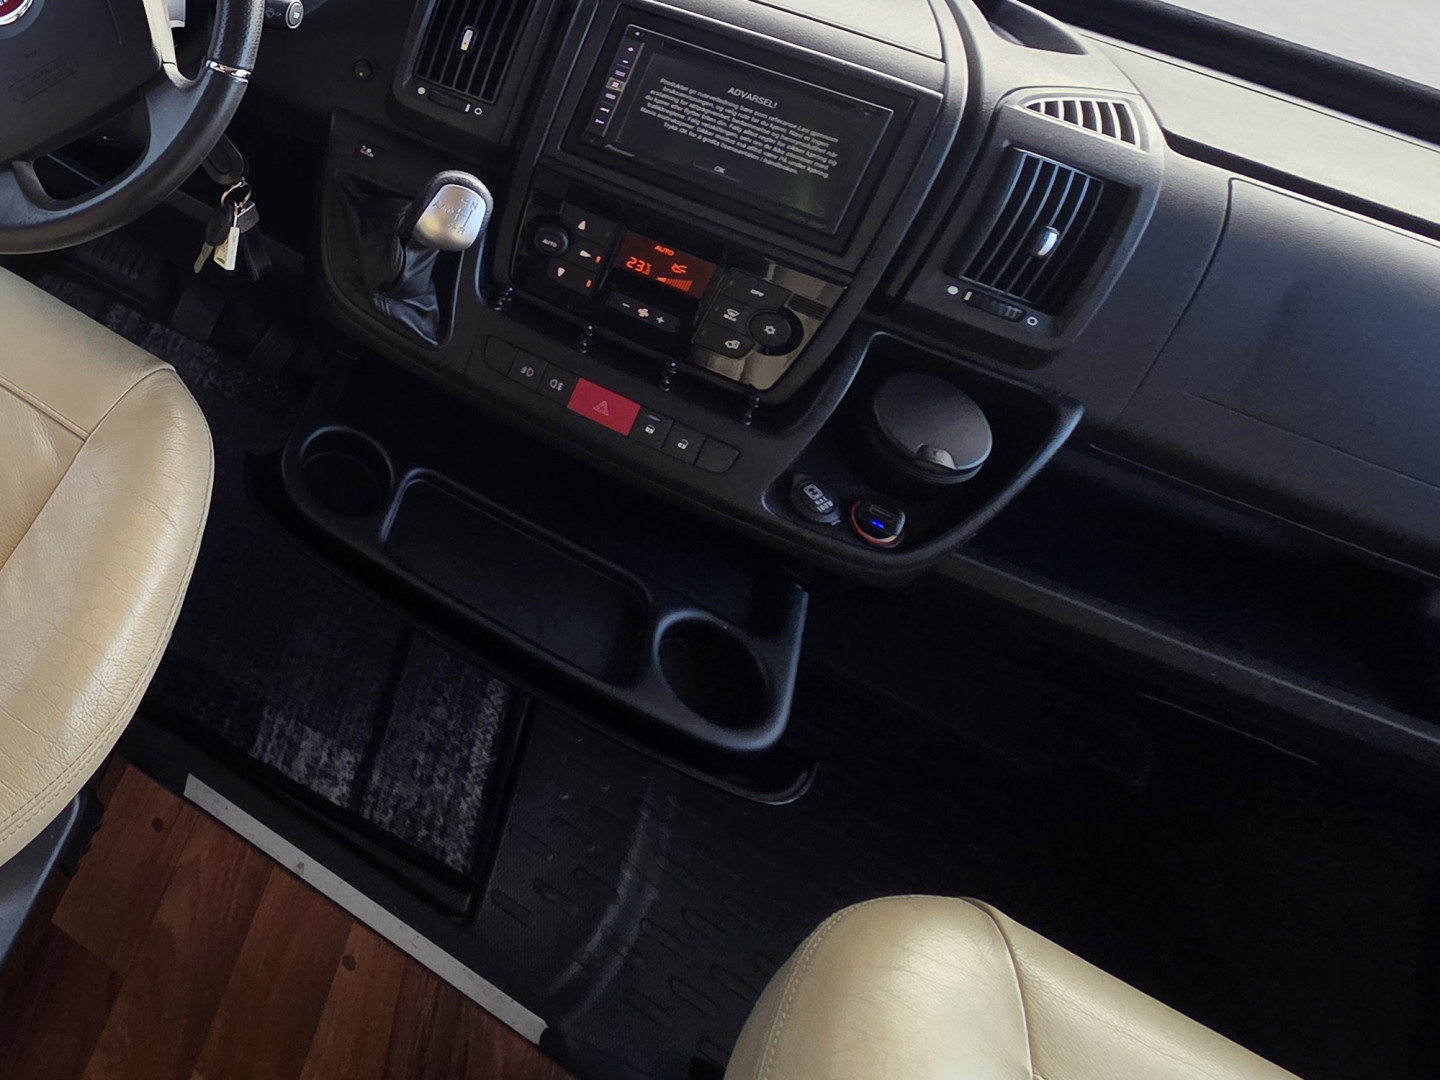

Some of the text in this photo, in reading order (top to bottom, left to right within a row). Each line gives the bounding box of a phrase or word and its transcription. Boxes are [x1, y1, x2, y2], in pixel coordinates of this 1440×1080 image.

[727, 87, 778, 109] ADVARSEL!
[714, 166, 726, 174] OK
[542, 238, 558, 248] AUTO
[654, 245, 675, 257] AUTO
